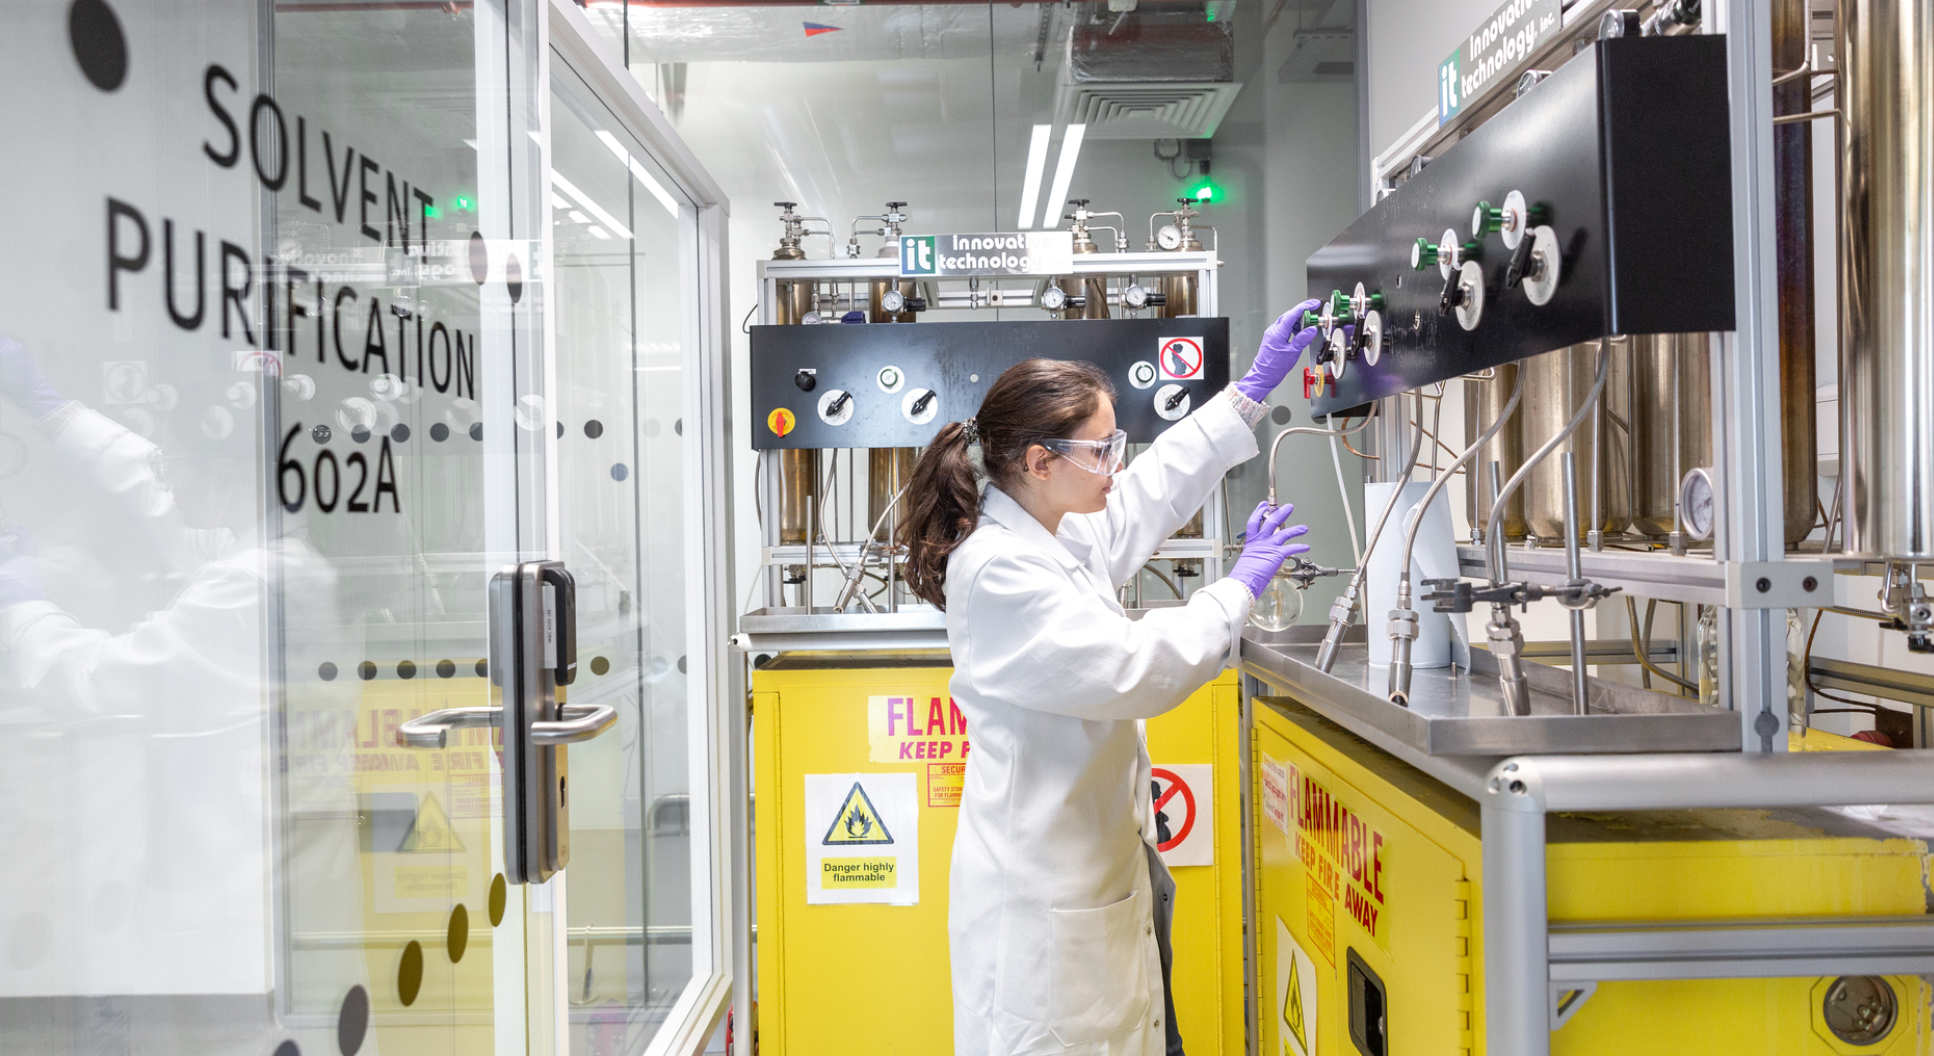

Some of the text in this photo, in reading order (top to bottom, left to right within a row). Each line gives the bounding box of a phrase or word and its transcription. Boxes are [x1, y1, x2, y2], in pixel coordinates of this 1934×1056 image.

[1469, 0, 1539, 61] Innovati
[1441, 61, 1458, 117] it
[203, 64, 434, 263] SOLVENT
[906, 238, 931, 271] it
[939, 252, 1032, 272] technolog
[105, 196, 475, 401] PURIFICATION
[277, 423, 401, 514] 602A
[887, 697, 967, 736] FLAM
[899, 741, 952, 759] KEEP
[1290, 764, 1385, 906] FLAMMABLE
[824, 862, 894, 873] Danger highly
[833, 872, 886, 882] flammable
[1295, 830, 1316, 872] KEEP
[1318, 854, 1340, 902] FIRE
[1344, 882, 1378, 938] AWAY
